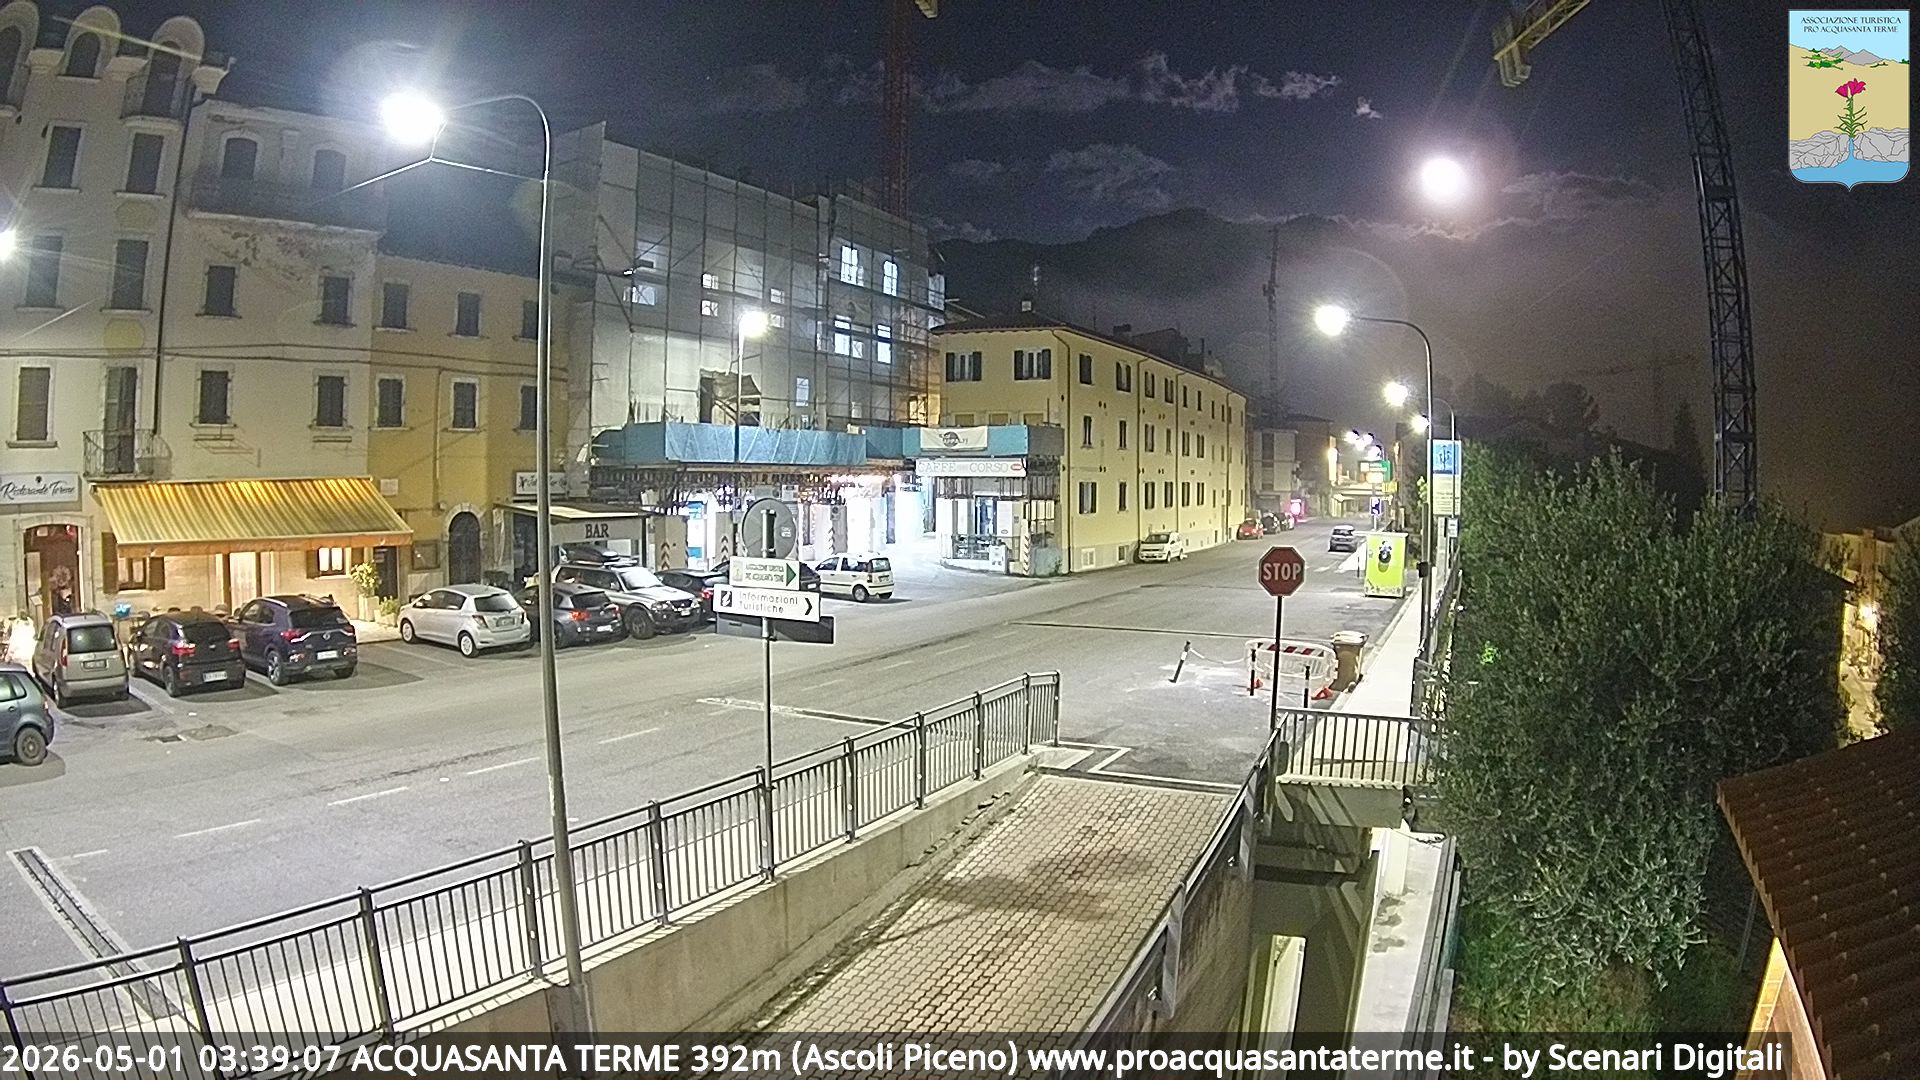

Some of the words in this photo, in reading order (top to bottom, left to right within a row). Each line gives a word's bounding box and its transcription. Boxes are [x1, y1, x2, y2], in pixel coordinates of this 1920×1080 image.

[969, 462, 1009, 473] CORSO
[585, 523, 610, 539] BAR
[1262, 562, 1301, 581] STOP
[739, 590, 798, 605] Informazioni
[739, 600, 784, 614] Turistiche
